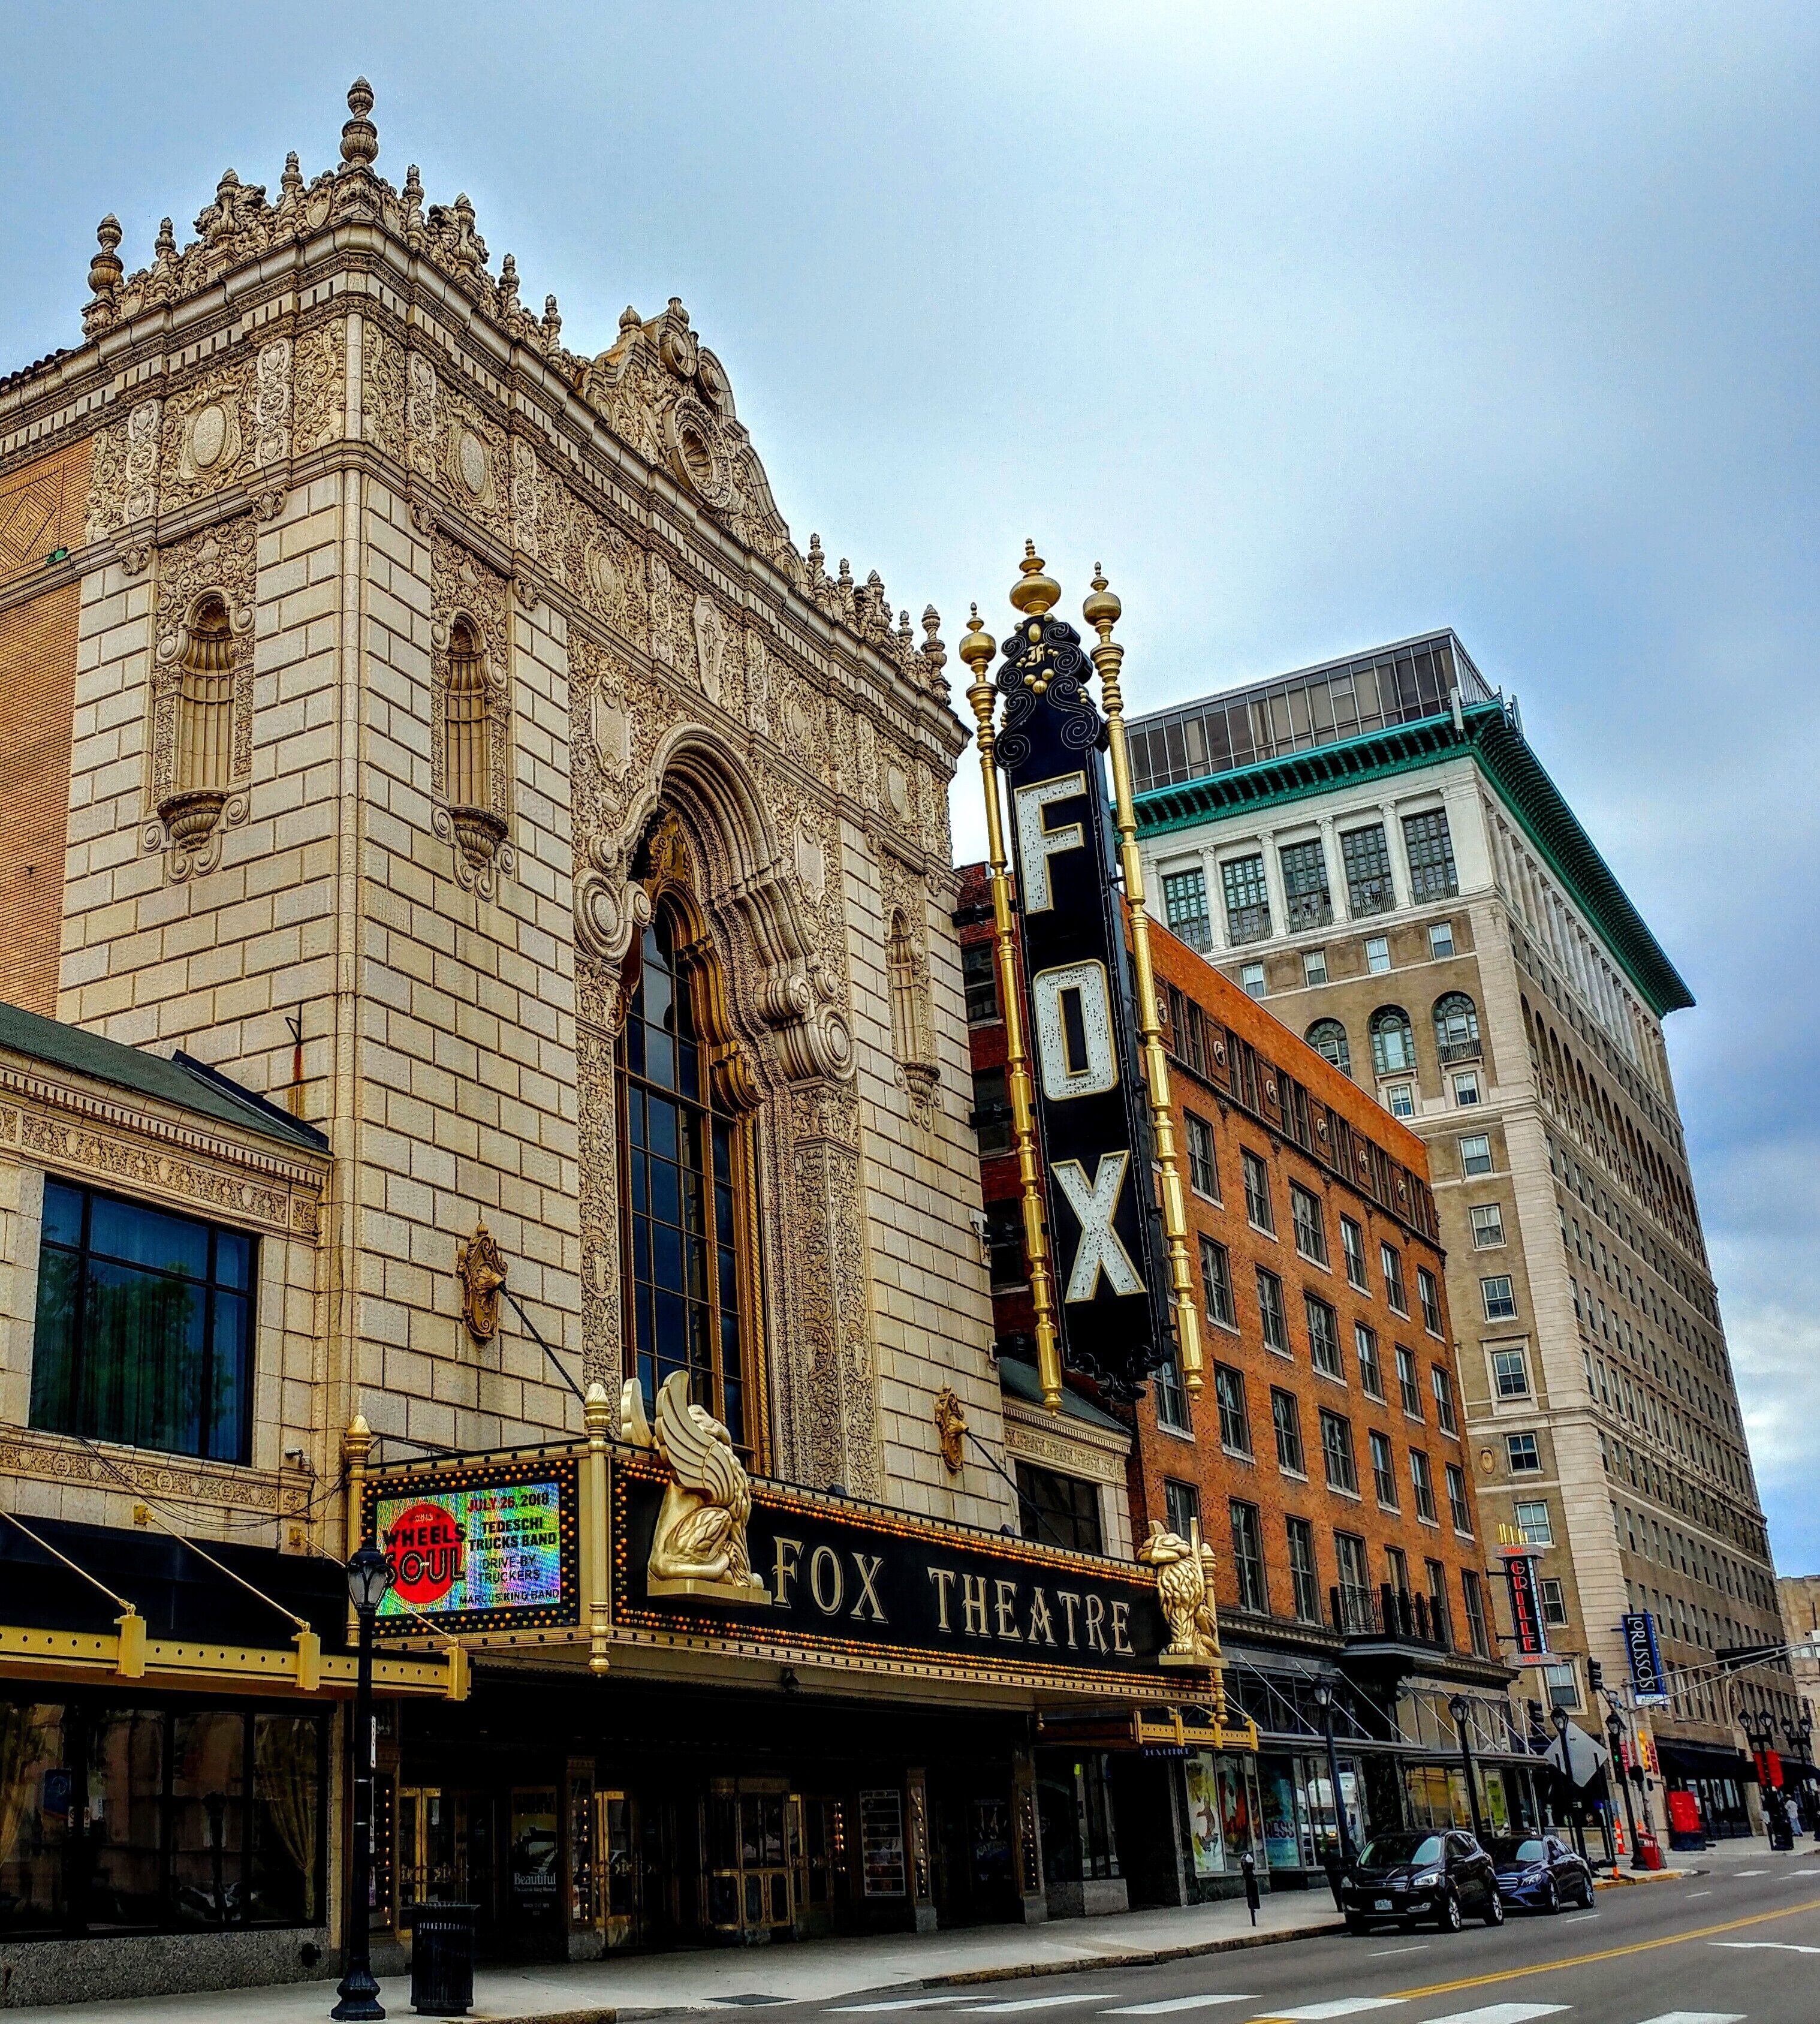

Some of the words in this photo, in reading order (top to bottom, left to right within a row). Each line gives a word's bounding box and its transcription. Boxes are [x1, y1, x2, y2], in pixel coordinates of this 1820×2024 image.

[1013, 770, 1147, 1303] FOX
[468, 1497, 497, 1513] JULY
[520, 1493, 549, 1507] 2018
[481, 1516, 543, 1534] TEDESCHI
[382, 1523, 467, 1549] WHEELS
[468, 1535, 519, 1552] TRUCKS
[522, 1532, 556, 1547] BAND
[384, 1547, 467, 1586] SOUL
[478, 1569, 540, 1583] TRUCKERS
[459, 1592, 501, 1604] MARCUS
[503, 1590, 528, 1601] KING
[772, 1535, 889, 1624] FOX
[926, 1565, 1137, 1656] THEATRE
[1511, 1561, 1538, 1651] GRILLE
[514, 1872, 556, 1885] Beautiful
